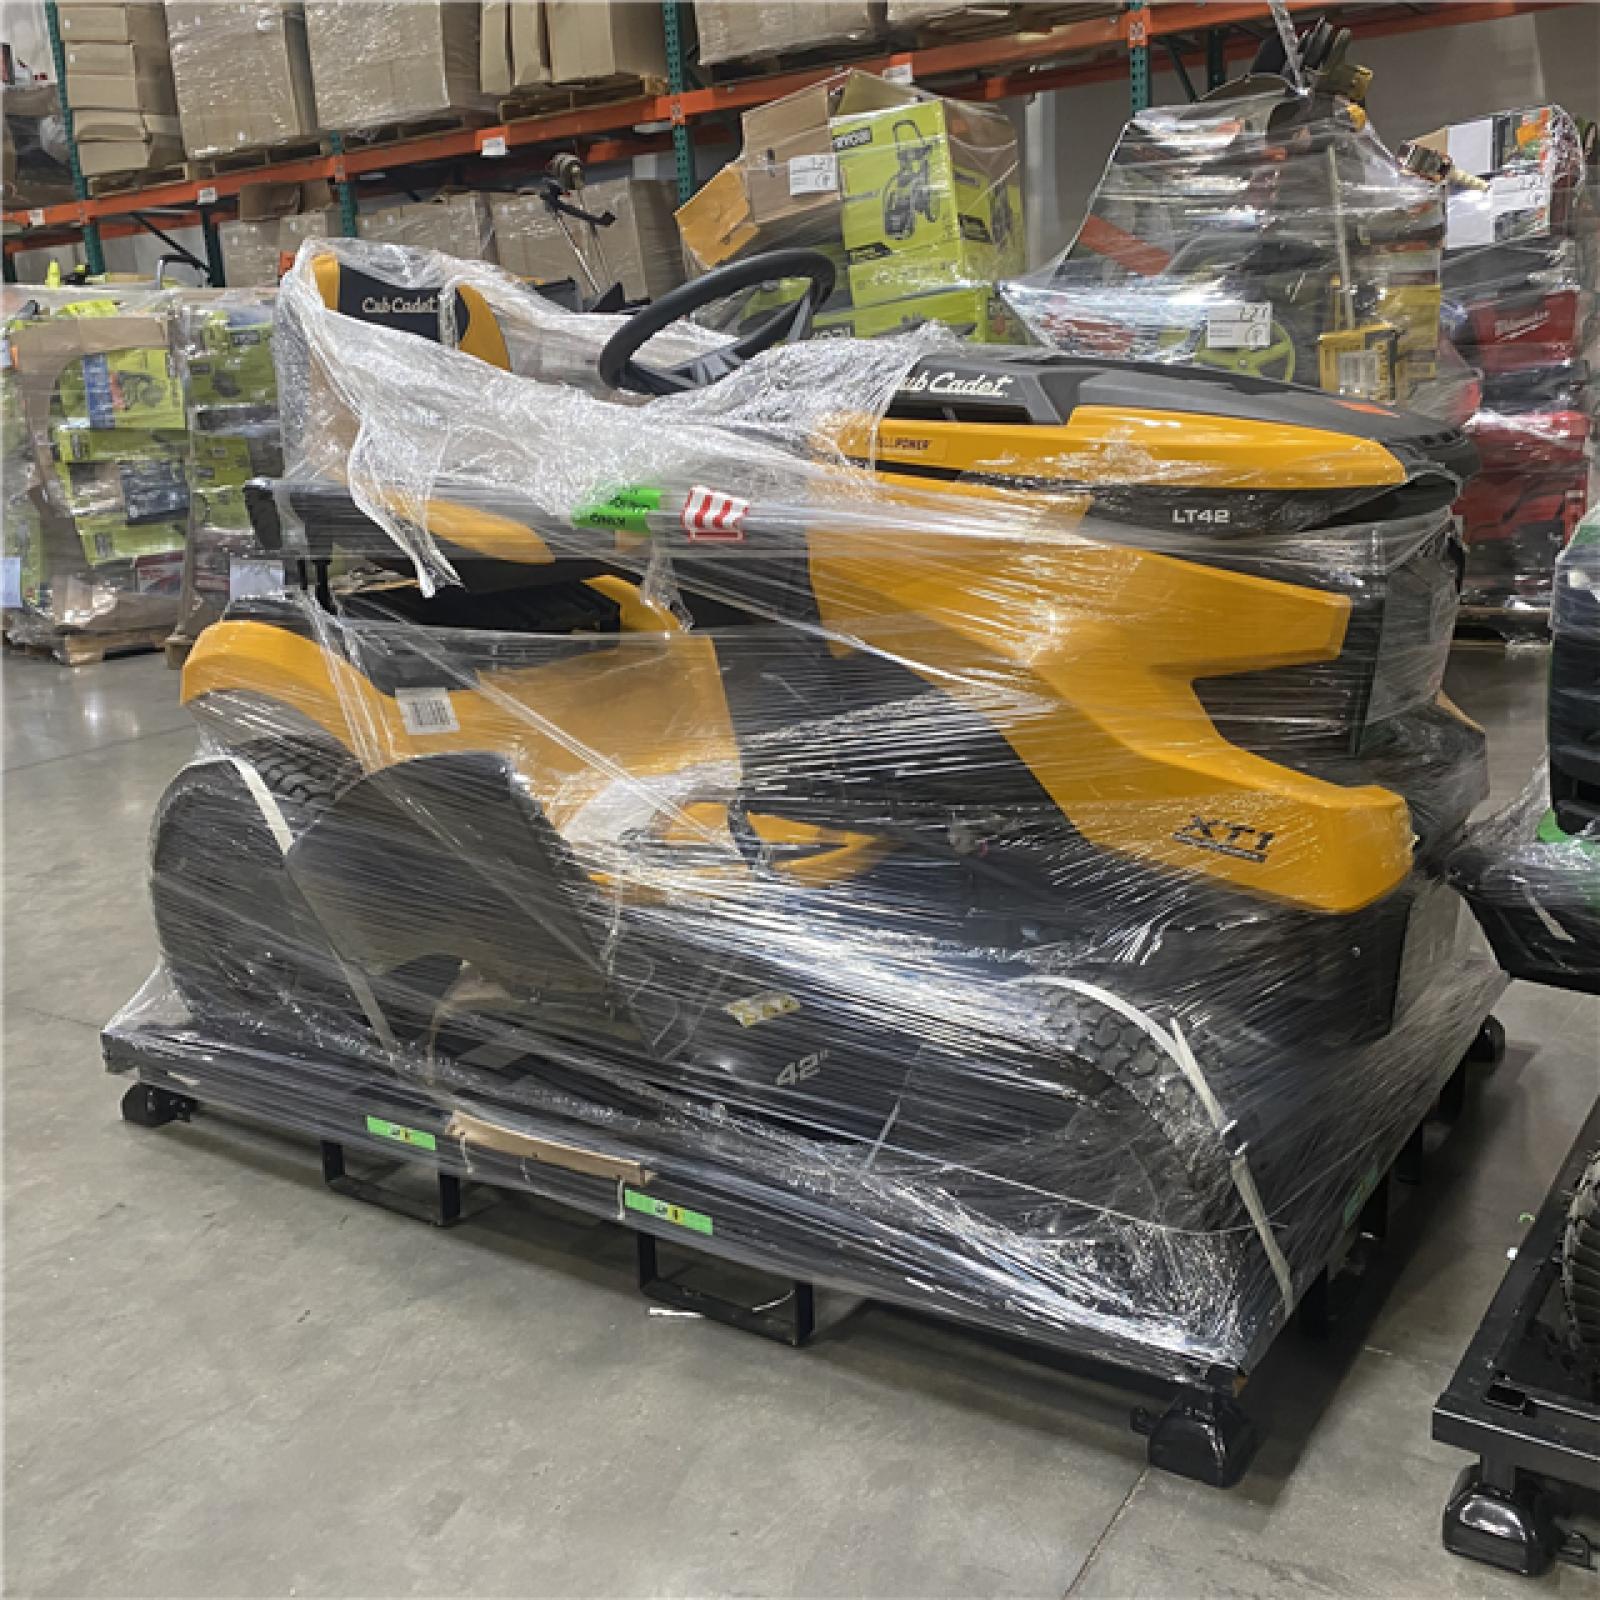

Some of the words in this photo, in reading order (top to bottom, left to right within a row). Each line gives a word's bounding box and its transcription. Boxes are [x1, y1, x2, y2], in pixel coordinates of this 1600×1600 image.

[362, 296, 391, 314] Cub
[391, 294, 439, 314] Cadet
[898, 370, 930, 392] ub
[929, 371, 1013, 398] Cadet
[1172, 509, 1231, 524] LT42
[1183, 814, 1276, 851] XT1
